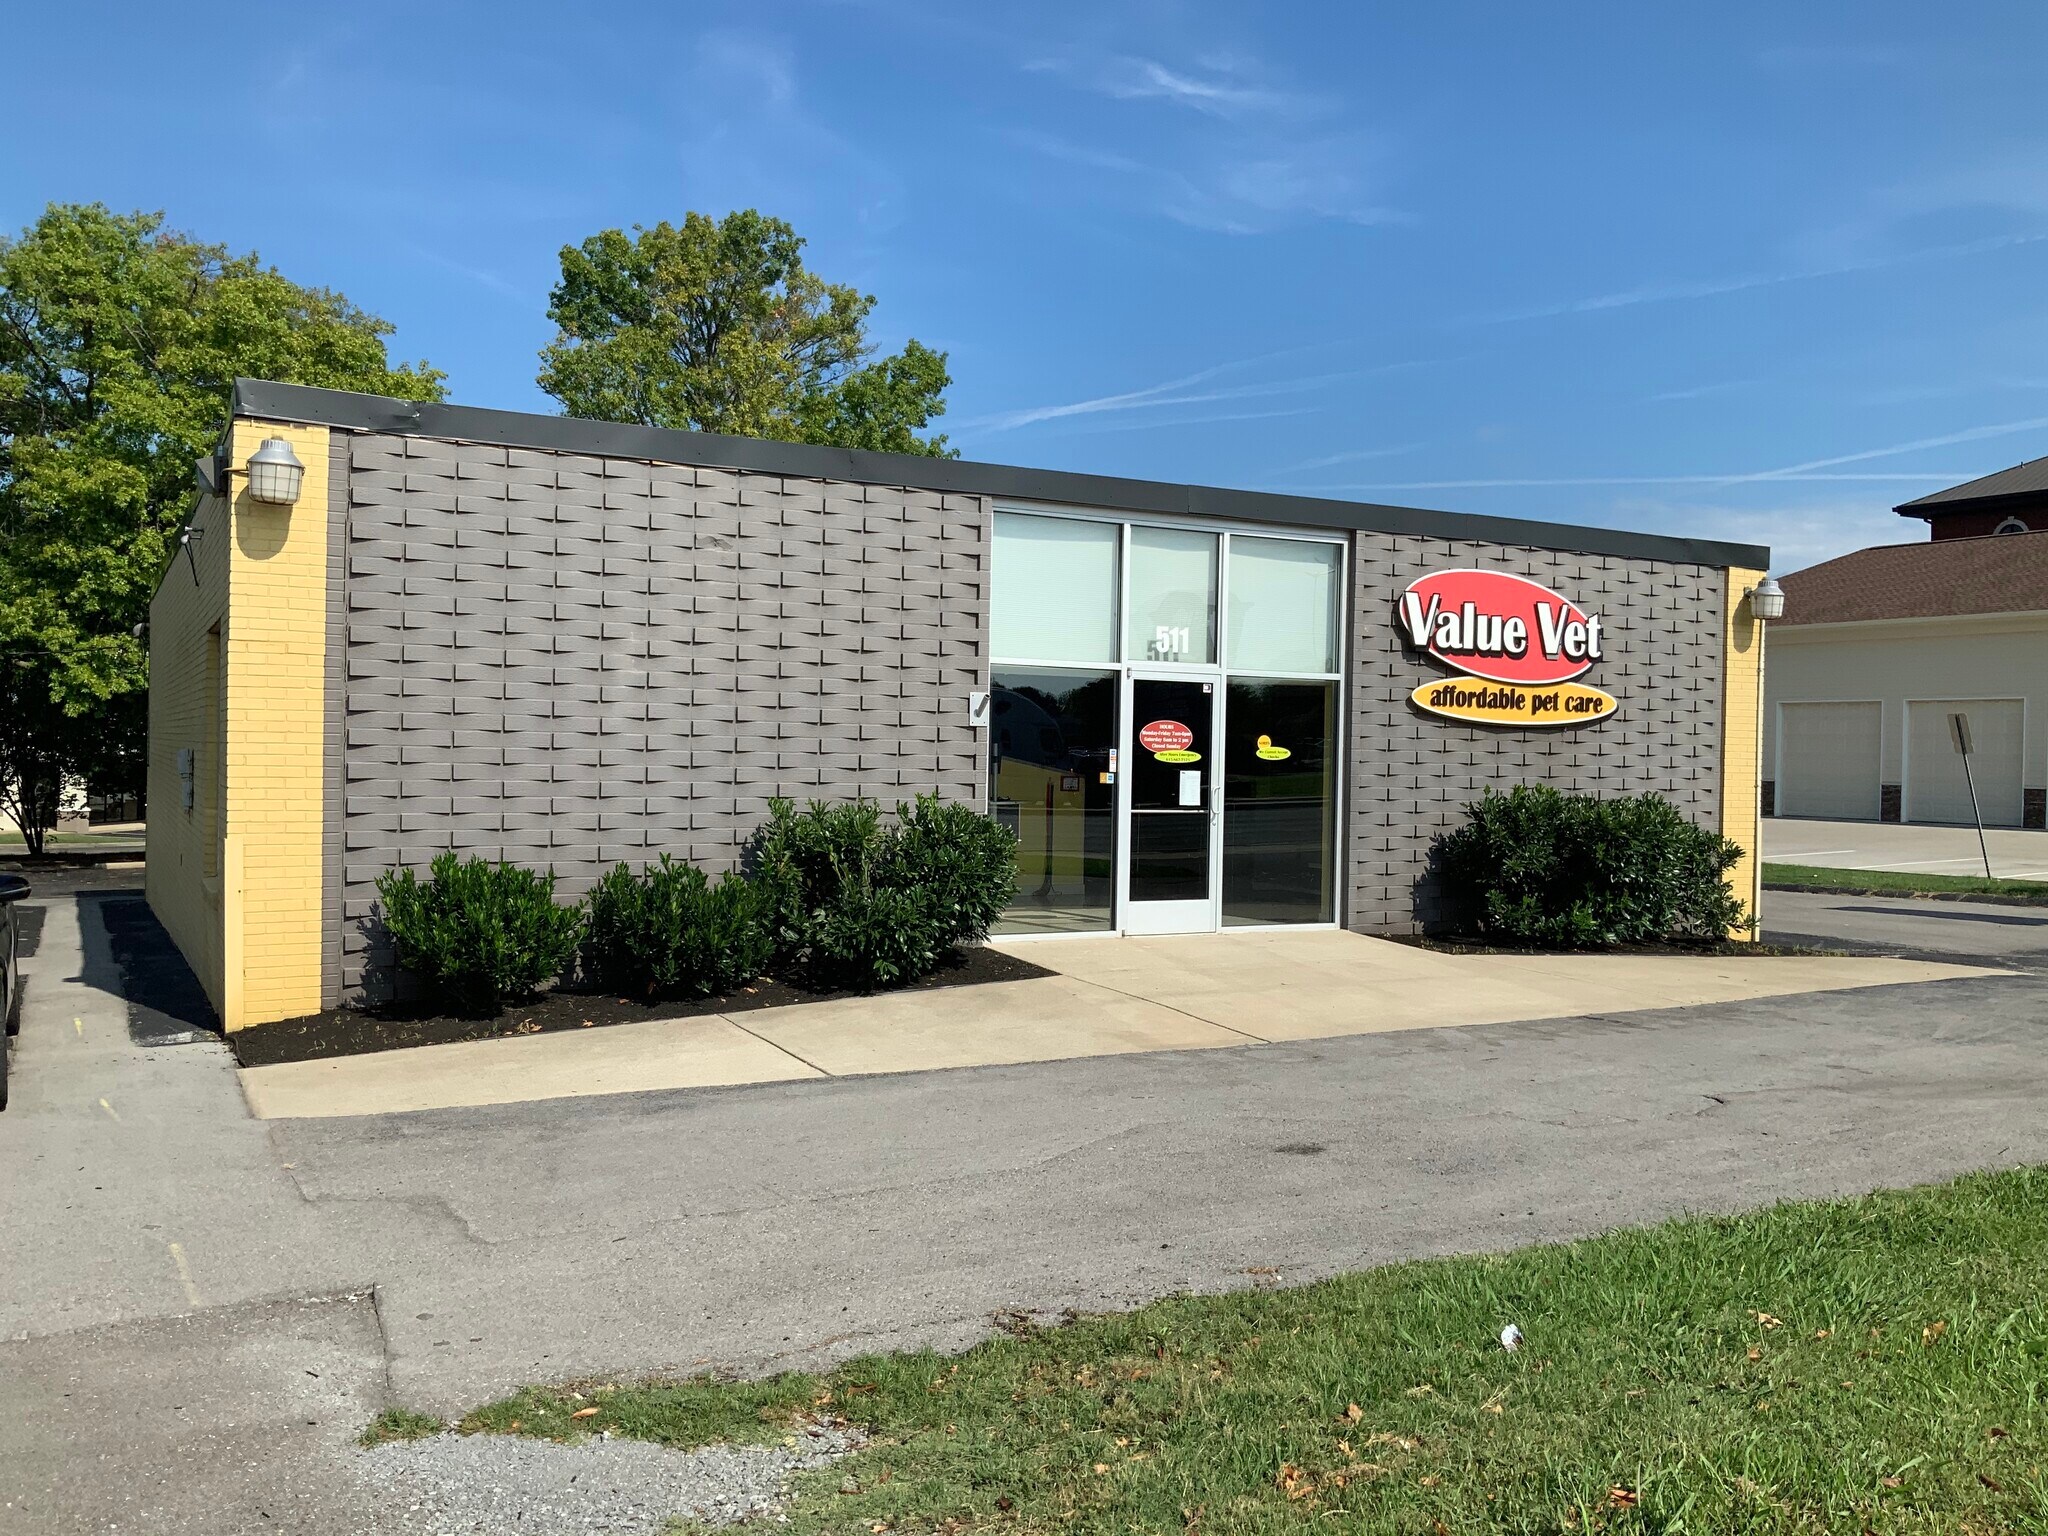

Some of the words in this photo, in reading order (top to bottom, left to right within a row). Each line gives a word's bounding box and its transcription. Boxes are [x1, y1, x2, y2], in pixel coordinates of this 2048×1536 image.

[1156, 625, 1189, 653] 511
[1403, 590, 1528, 655] Value
[1536, 600, 1602, 659] Vet
[1430, 685, 1526, 709] affordable
[1531, 691, 1559, 715] pet
[1564, 694, 1604, 713] care
